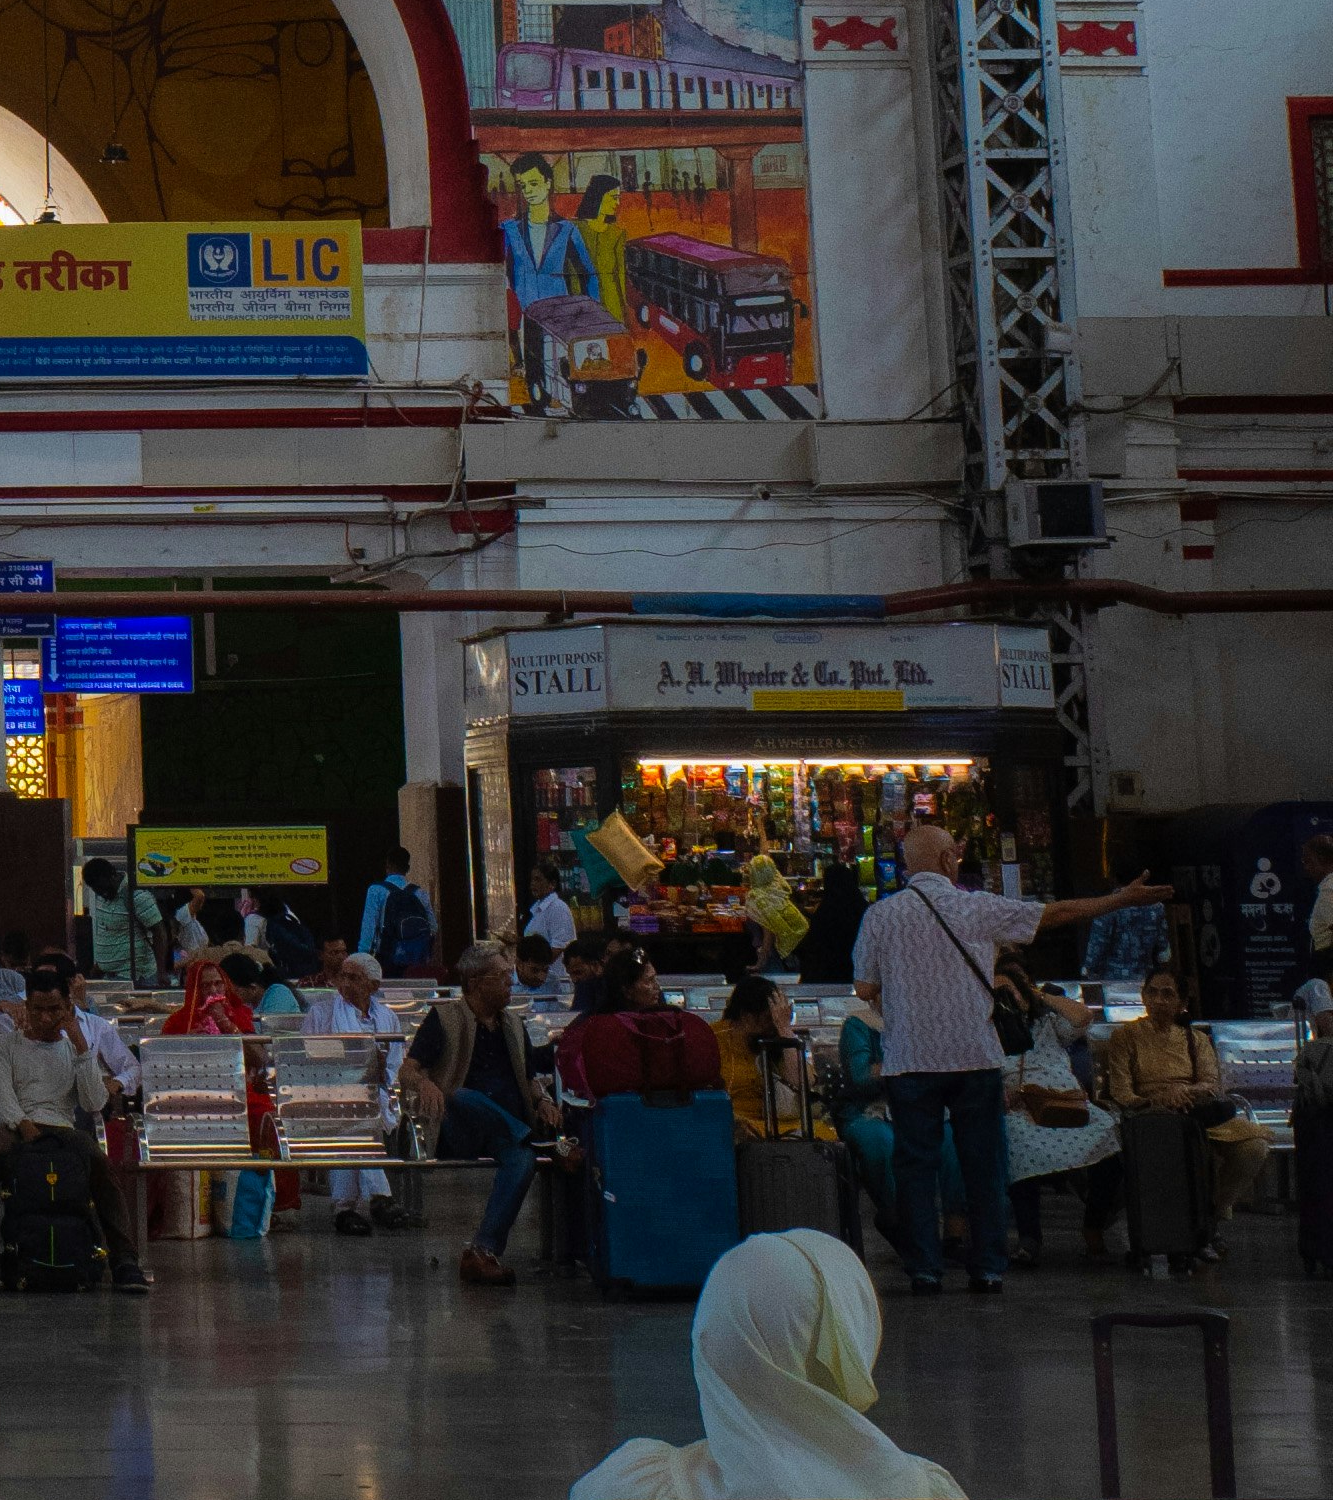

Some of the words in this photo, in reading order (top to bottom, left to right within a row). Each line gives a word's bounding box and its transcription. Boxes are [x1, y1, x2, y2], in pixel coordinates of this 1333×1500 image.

[14, 249, 133, 292] तरीका
[261, 237, 341, 282] LIC
[189, 287, 232, 299] भारतीय
[189, 300, 234, 312] भारतीय
[243, 300, 277, 312] जीवन
[284, 300, 311, 312] बीमा
[319, 300, 351, 312] निगम
[7, 573, 25, 586] सी
[27, 573, 44, 586] ओ
[510, 651, 603, 669] MULTIPURPOSE
[515, 667, 602, 696] STALL
[656, 661, 683, 694] A.
[713, 660, 788, 694] Wheeler
[791, 661, 809, 687] &
[813, 660, 846, 687] Co.
[893, 660, 934, 691] Ltd.
[1001, 663, 1051, 690] STALL
